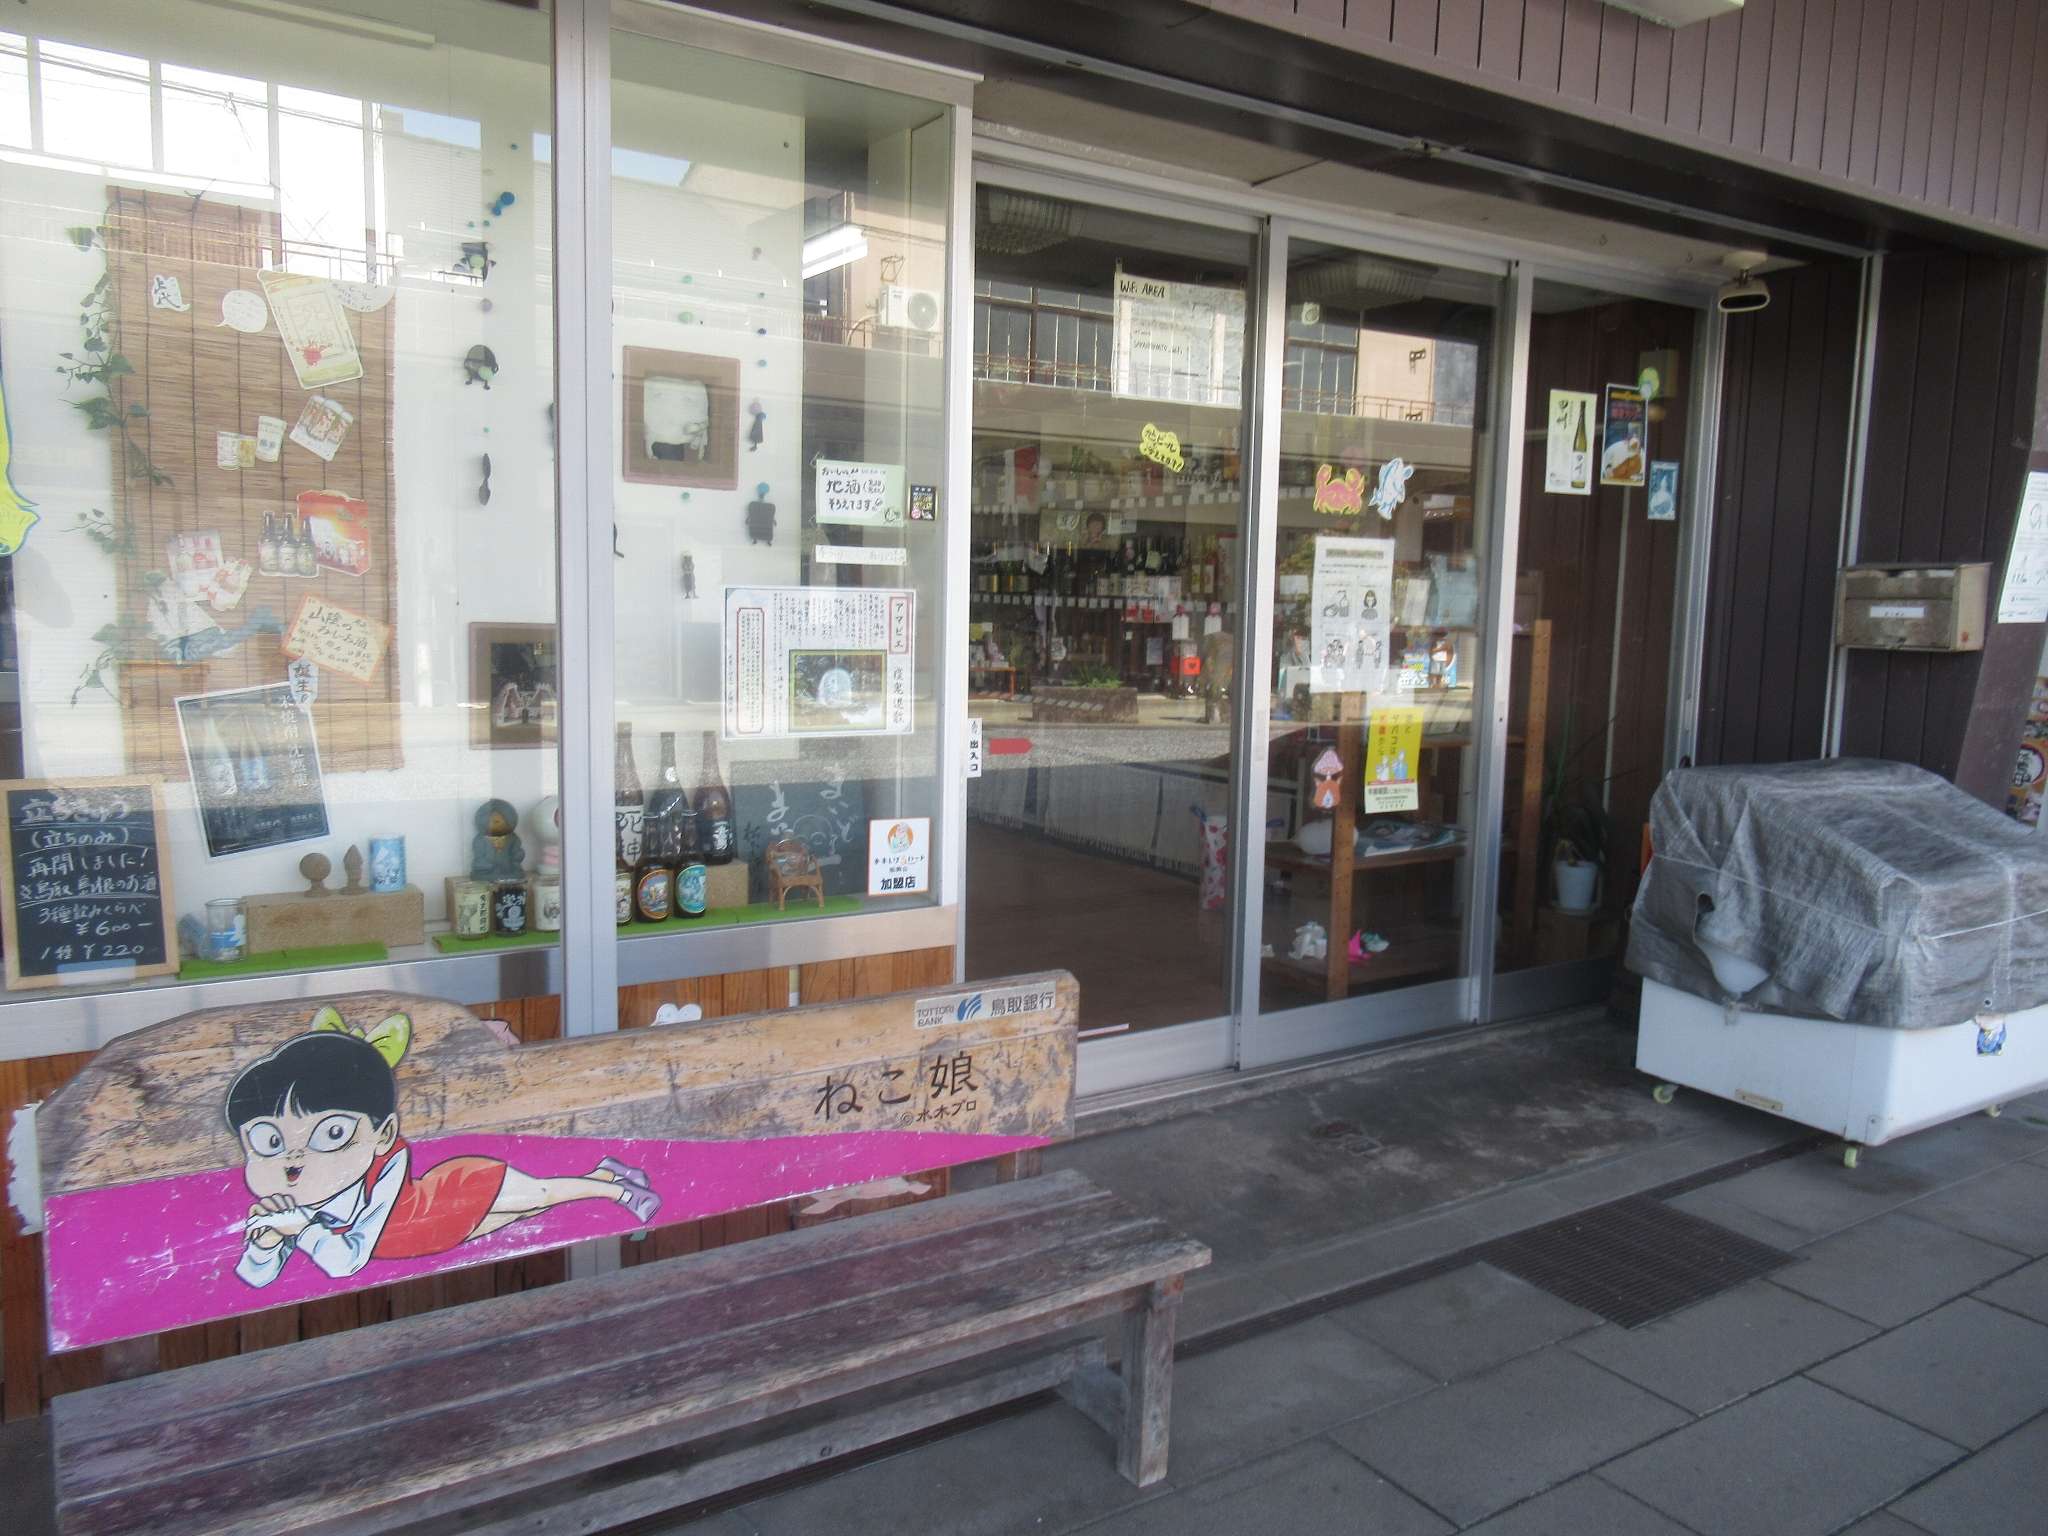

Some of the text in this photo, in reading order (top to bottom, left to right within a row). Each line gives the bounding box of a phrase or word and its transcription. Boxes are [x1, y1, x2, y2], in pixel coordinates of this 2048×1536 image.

[826, 480, 861, 495] 地酒
[895, 602, 904, 648] アマビエ
[970, 740, 979, 771] 出入口
[881, 876, 916, 890] 加盟店
[917, 1004, 955, 1018] TOTTORI
[990, 991, 1055, 1017] 鳥取銀行
[917, 1016, 944, 1027] BANK
[814, 1051, 978, 1120] ねこ娘
